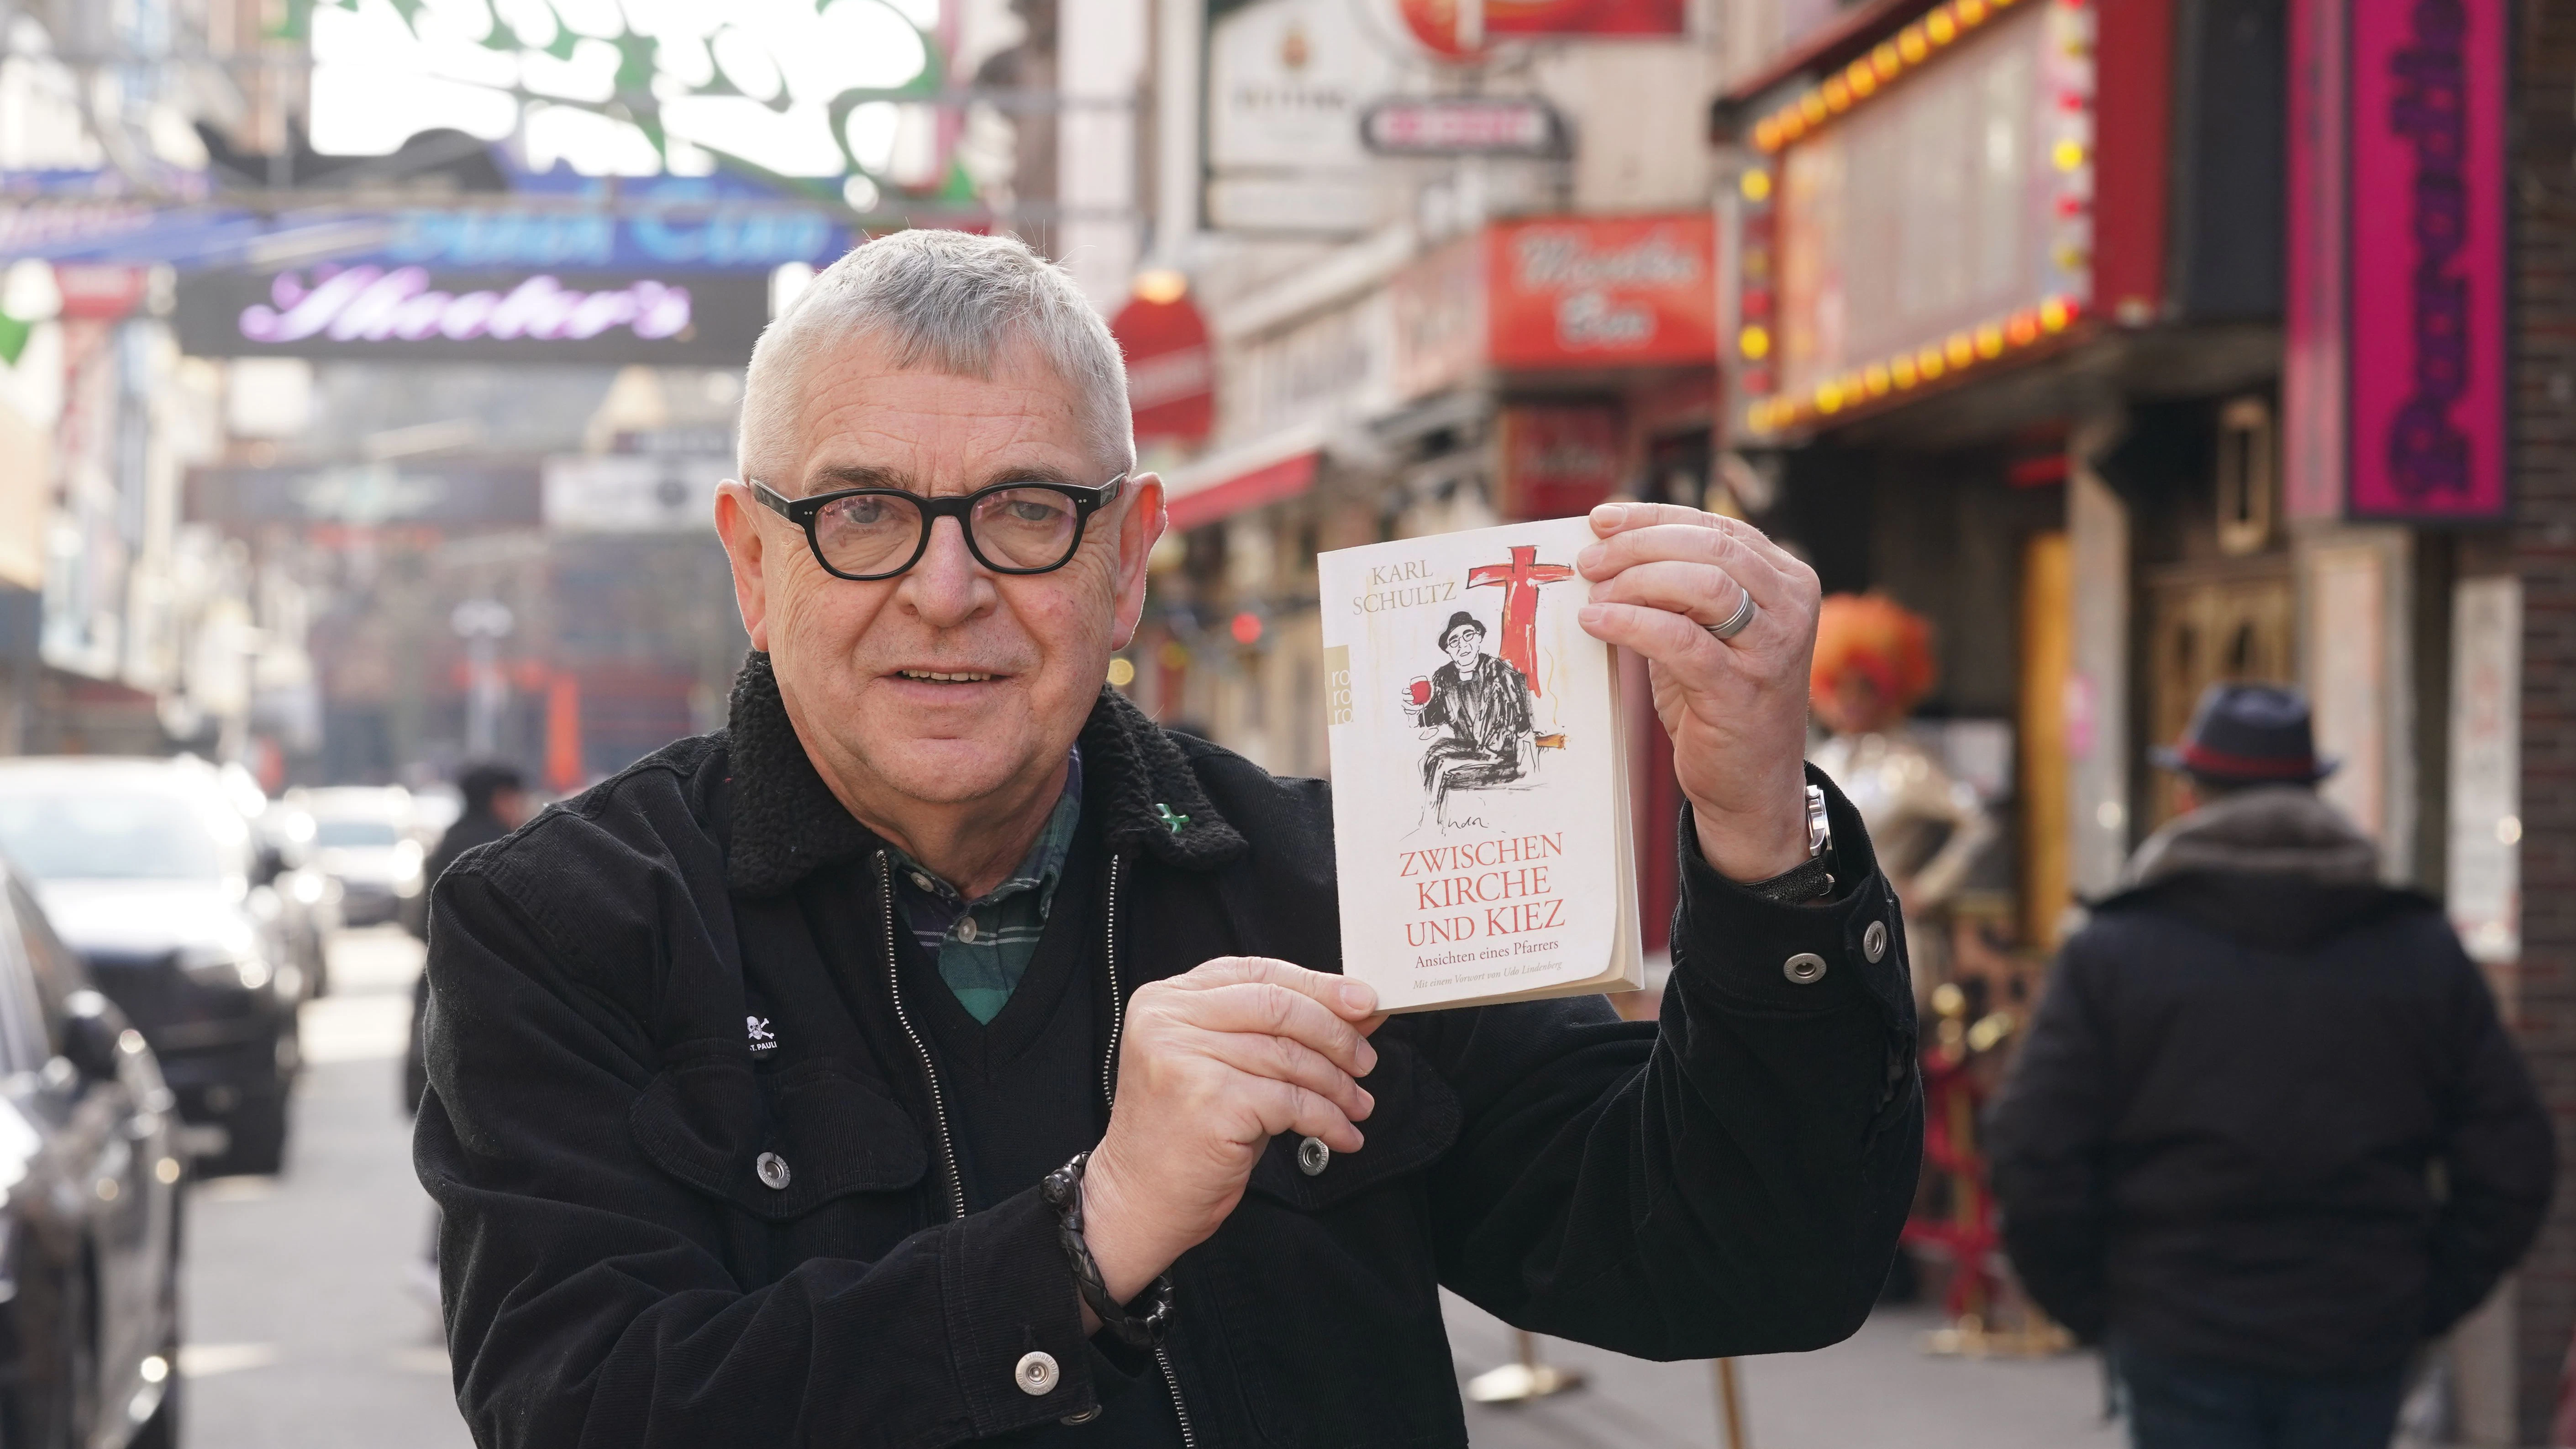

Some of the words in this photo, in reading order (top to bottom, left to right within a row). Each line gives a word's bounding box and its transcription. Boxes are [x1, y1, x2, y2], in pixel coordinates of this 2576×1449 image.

[1371, 559, 1434, 585] KARL
[1352, 582, 1457, 615] SCHULTZ
[1331, 669, 1351, 687] ro
[1333, 688, 1352, 706] ro
[1334, 708, 1354, 725] ro
[1399, 832, 1563, 877] ZWISCHEN
[1416, 866, 1551, 910] KIRCHE
[1404, 916, 1475, 947] UND
[1484, 898, 1566, 937] KIEZ
[1415, 950, 1476, 969] Ansichten
[1479, 947, 1509, 960] eines
[1513, 940, 1559, 955] Pfarrers
[1413, 980, 1428, 990] Mit
[1430, 978, 1452, 987] einem
[1455, 972, 1485, 983] Vorwort
[1487, 971, 1501, 979] von
[1504, 966, 1519, 977] Udo
[1521, 960, 1563, 975] Lindenberg
[756, 1041, 778, 1050] PAULI
